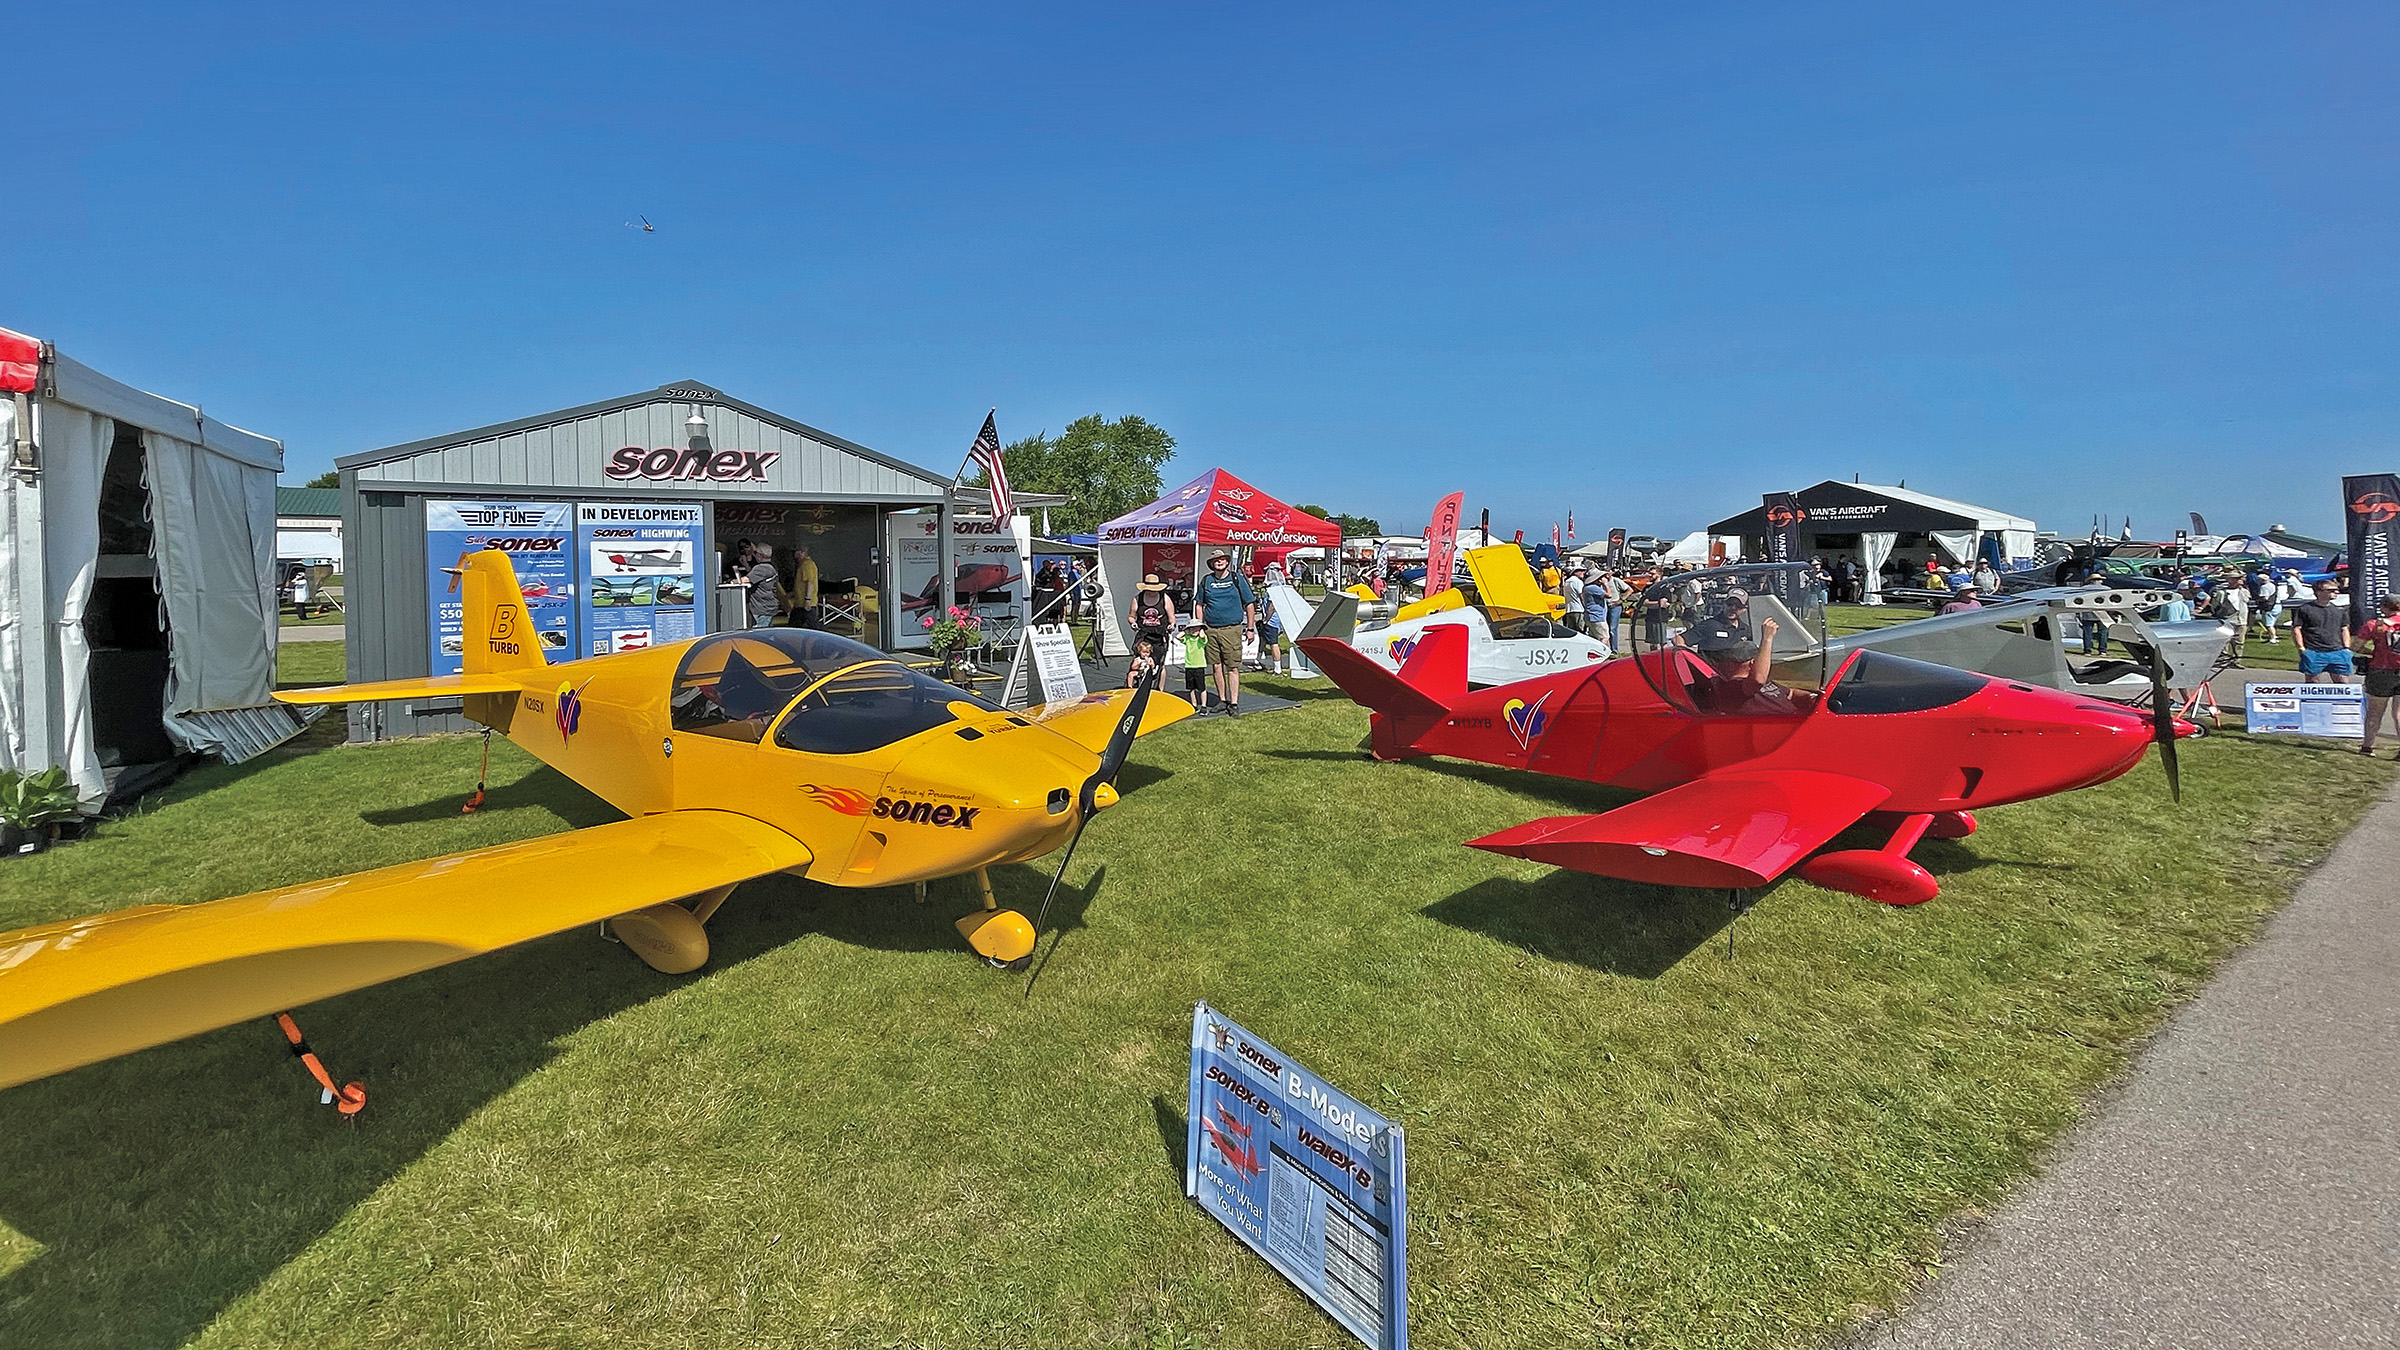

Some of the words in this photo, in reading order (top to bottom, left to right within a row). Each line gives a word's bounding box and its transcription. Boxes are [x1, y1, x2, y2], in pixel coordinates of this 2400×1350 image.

[665, 387, 717, 399] sonex
[604, 446, 781, 482] sonex
[479, 511, 499, 523] TOP
[503, 511, 527, 523] FUN
[582, 508, 596, 519] IN
[601, 508, 699, 521] DEVELOPMENT:
[1810, 507, 1837, 515] VAN'S
[1838, 505, 1888, 515] AIRCRAFT
[593, 528, 637, 538] sonex
[641, 529, 689, 538] HIGHWING
[1105, 526, 1139, 540] sonex
[1140, 525, 1176, 537] aircraft
[483, 537, 566, 551] sonex
[982, 544, 1017, 553] sonex
[2373, 532, 2389, 566] VAN'S
[489, 604, 518, 641] B
[488, 641, 520, 655] TURBO
[1050, 638, 1071, 647] Specials
[1525, 649, 1569, 666] JSX-2
[2252, 686, 2296, 694] sonex
[2300, 687, 2351, 695] HIGHWING
[872, 797, 981, 830] sonex
[1237, 1041, 1283, 1078] sonex
[1205, 1066, 1270, 1116] sonex-B
[1288, 1072, 1388, 1158] B-Models
[1198, 1161, 1224, 1188] More
[1225, 1183, 1236, 1197] of
[1236, 1188, 1263, 1221] What
[1217, 1191, 1234, 1217] You
[1235, 1207, 1262, 1240] Want
